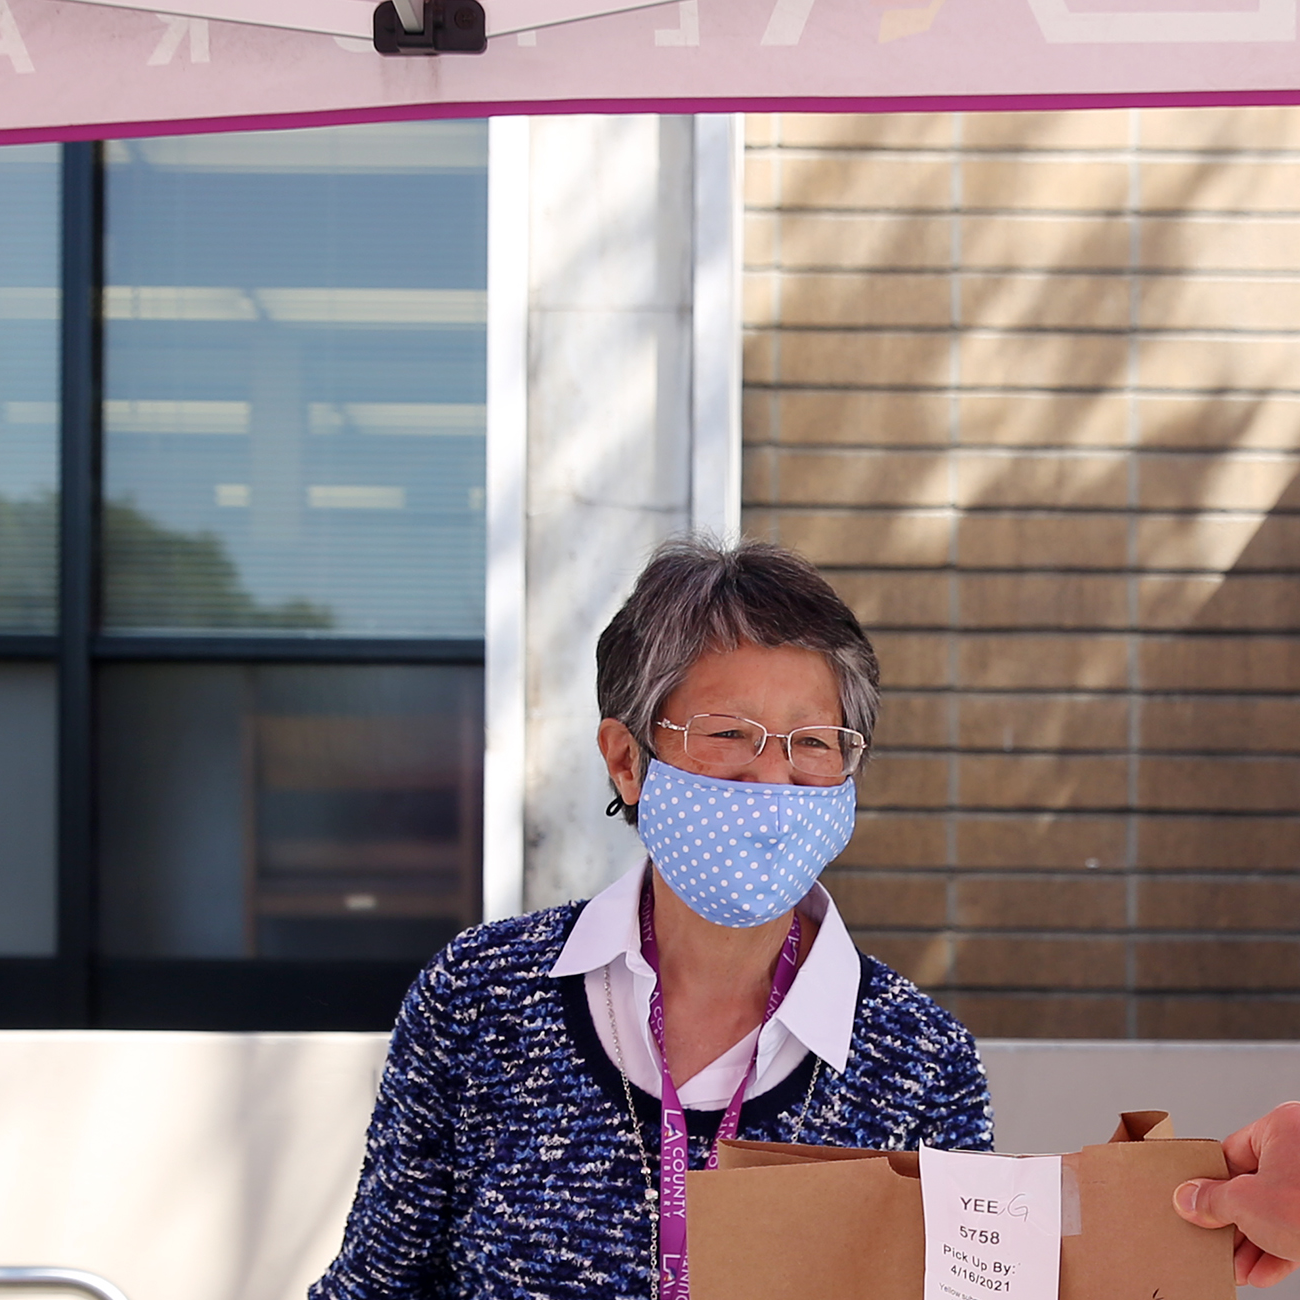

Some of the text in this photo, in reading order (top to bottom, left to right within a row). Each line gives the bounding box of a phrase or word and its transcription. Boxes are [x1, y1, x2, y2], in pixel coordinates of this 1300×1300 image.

[673, 1147, 685, 1218] COUNTY
[960, 1197, 998, 1214] YEE
[960, 1225, 1000, 1244] 5758
[943, 1244, 1016, 1276] Pick Up By:
[951, 1265, 1010, 1292] 4/16/2021
[939, 1283, 961, 1298] Yellow
